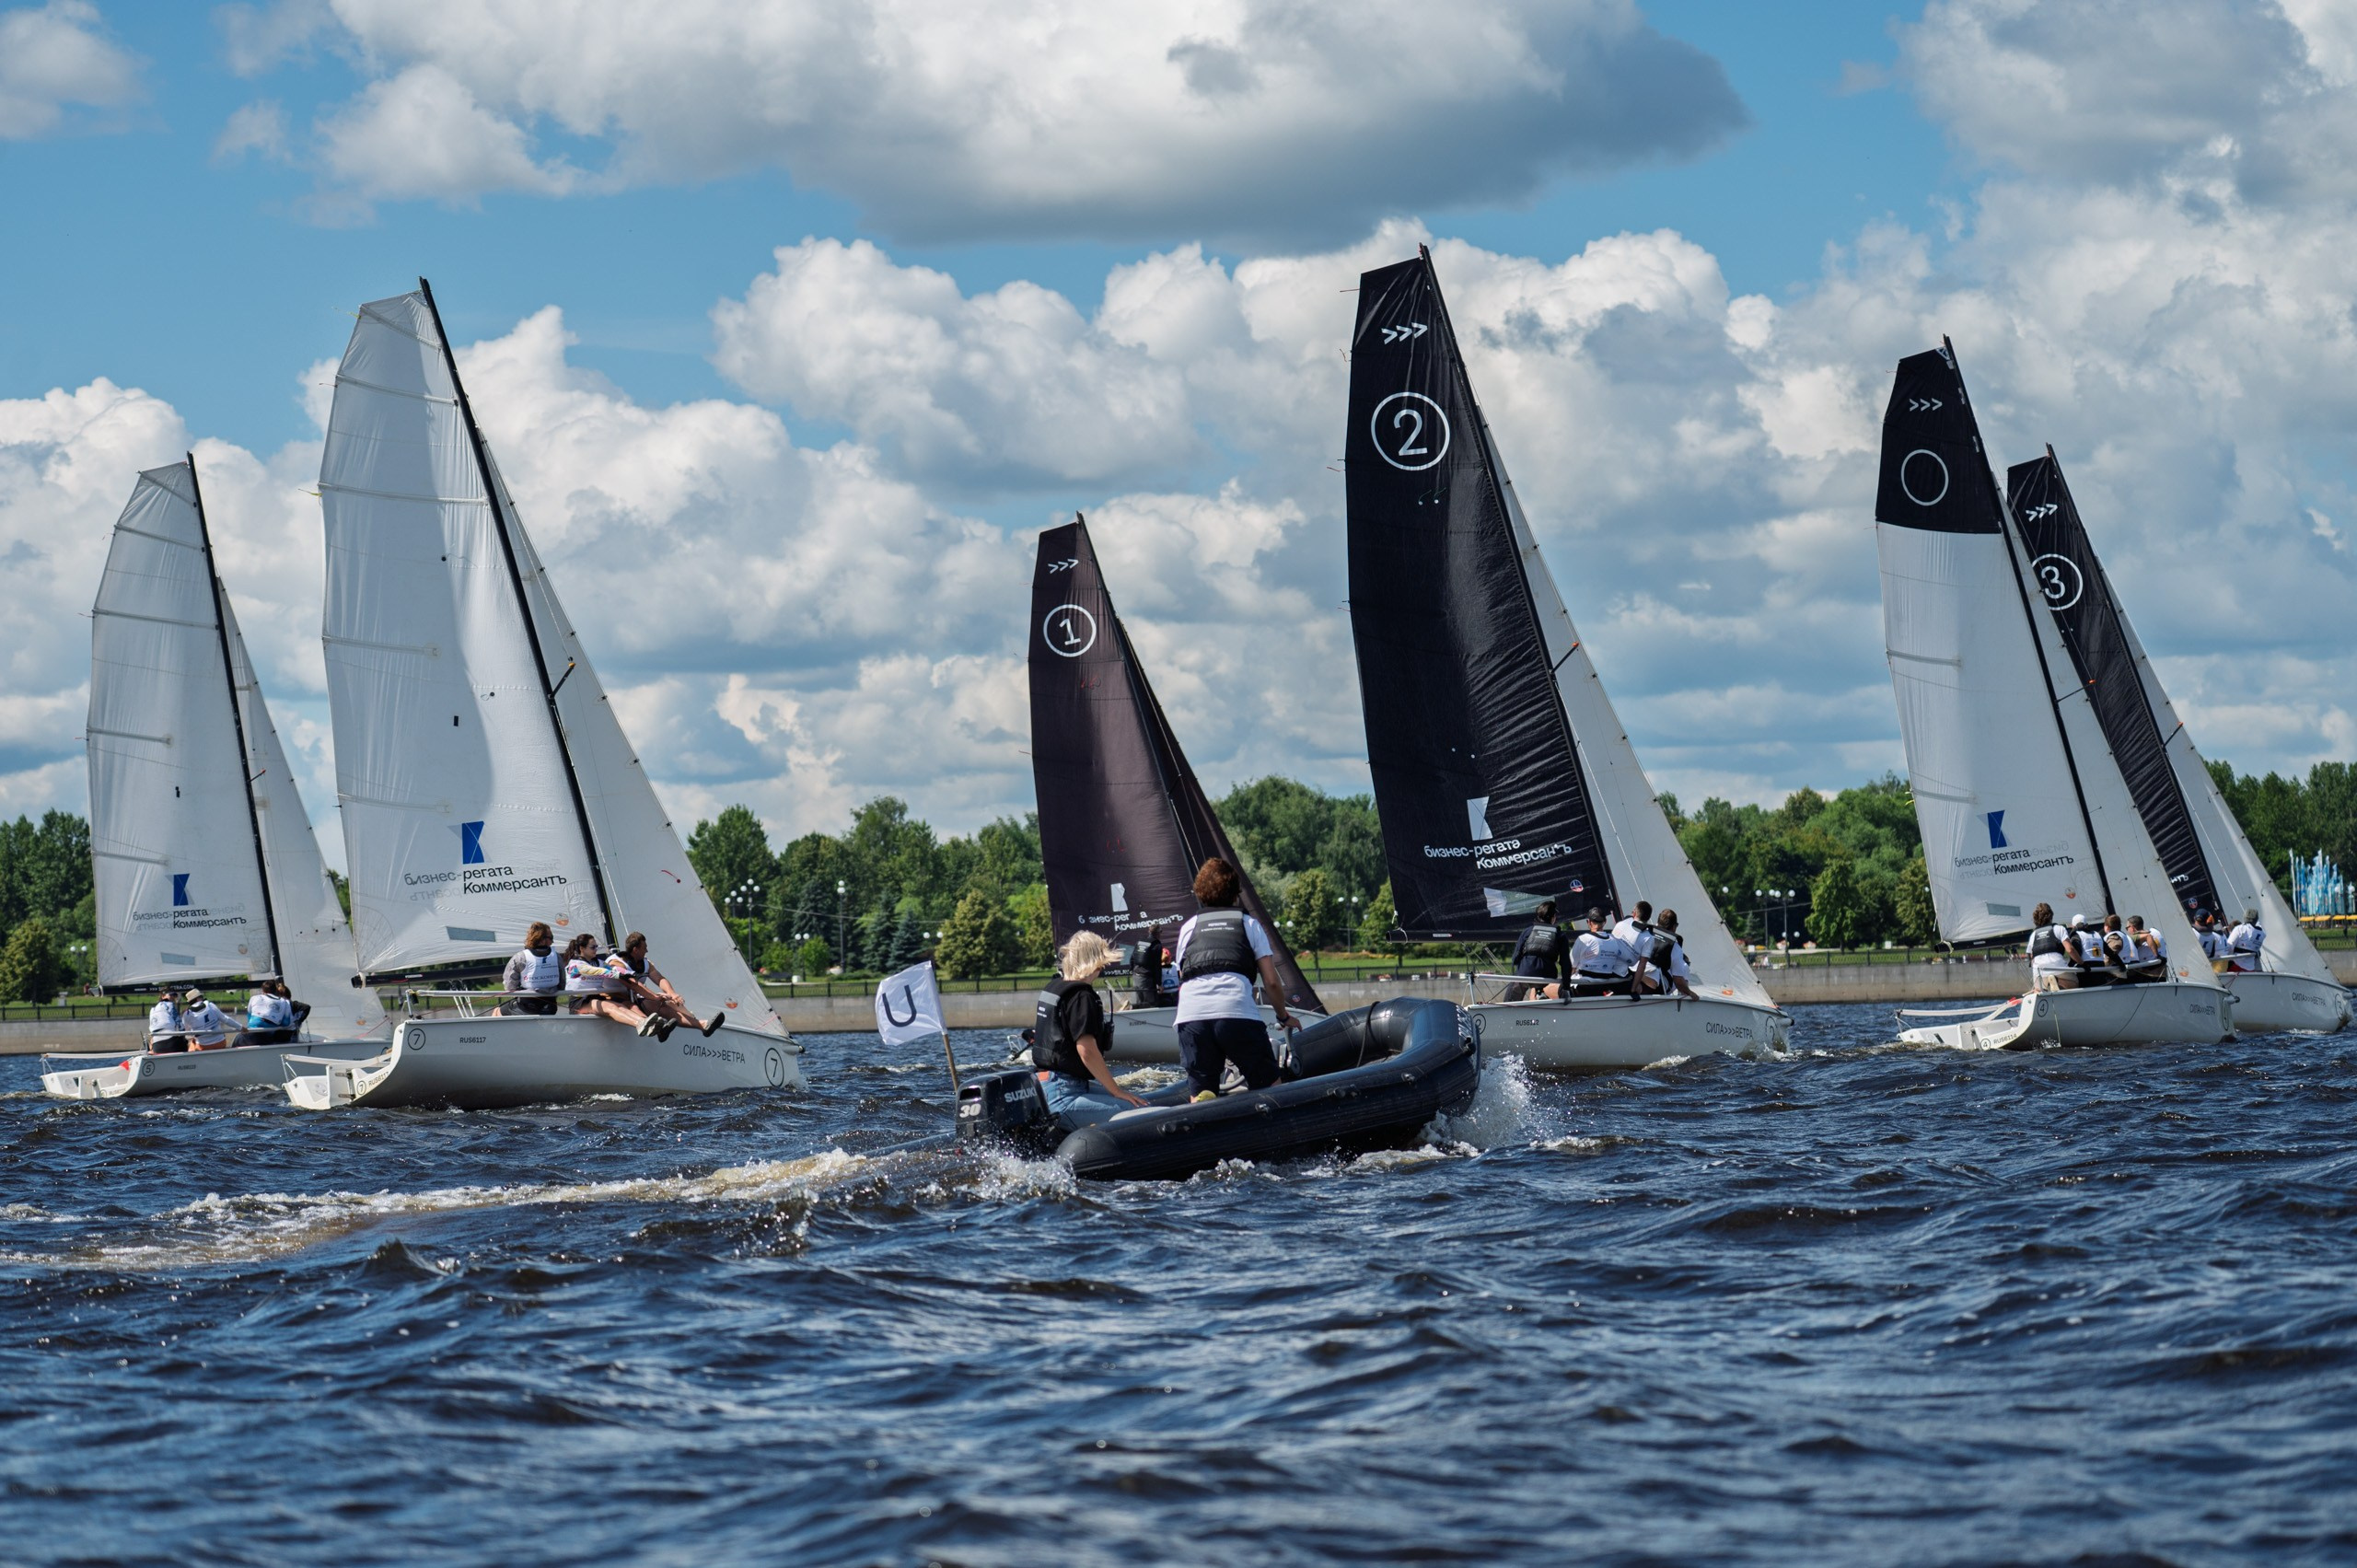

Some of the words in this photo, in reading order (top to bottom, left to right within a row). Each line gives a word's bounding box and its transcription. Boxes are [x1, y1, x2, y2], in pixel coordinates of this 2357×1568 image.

[1393, 409, 1428, 456] 2
[2041, 565, 2065, 598] 3
[1059, 618, 1081, 645] 1
[1423, 839, 1521, 858] бизнес-регата
[1954, 849, 2031, 867] бизнес-регата
[1993, 855, 2074, 875] Коммерсантъ
[403, 865, 514, 886] бизнес-регата
[463, 875, 567, 894] Коммерсантъ
[133, 908, 209, 921] бизнес-регата
[173, 917, 247, 929] Коммерсантъ
[1077, 911, 1148, 924] бзнес-рега
[881, 984, 917, 1028] U
[413, 1033, 421, 1045] 7
[145, 1065, 151, 1074] 5
[770, 1057, 778, 1078] 7
[358, 1084, 364, 1093] 7
[1004, 1086, 1038, 1103] SUZUKI
[959, 1103, 981, 1119] 30
